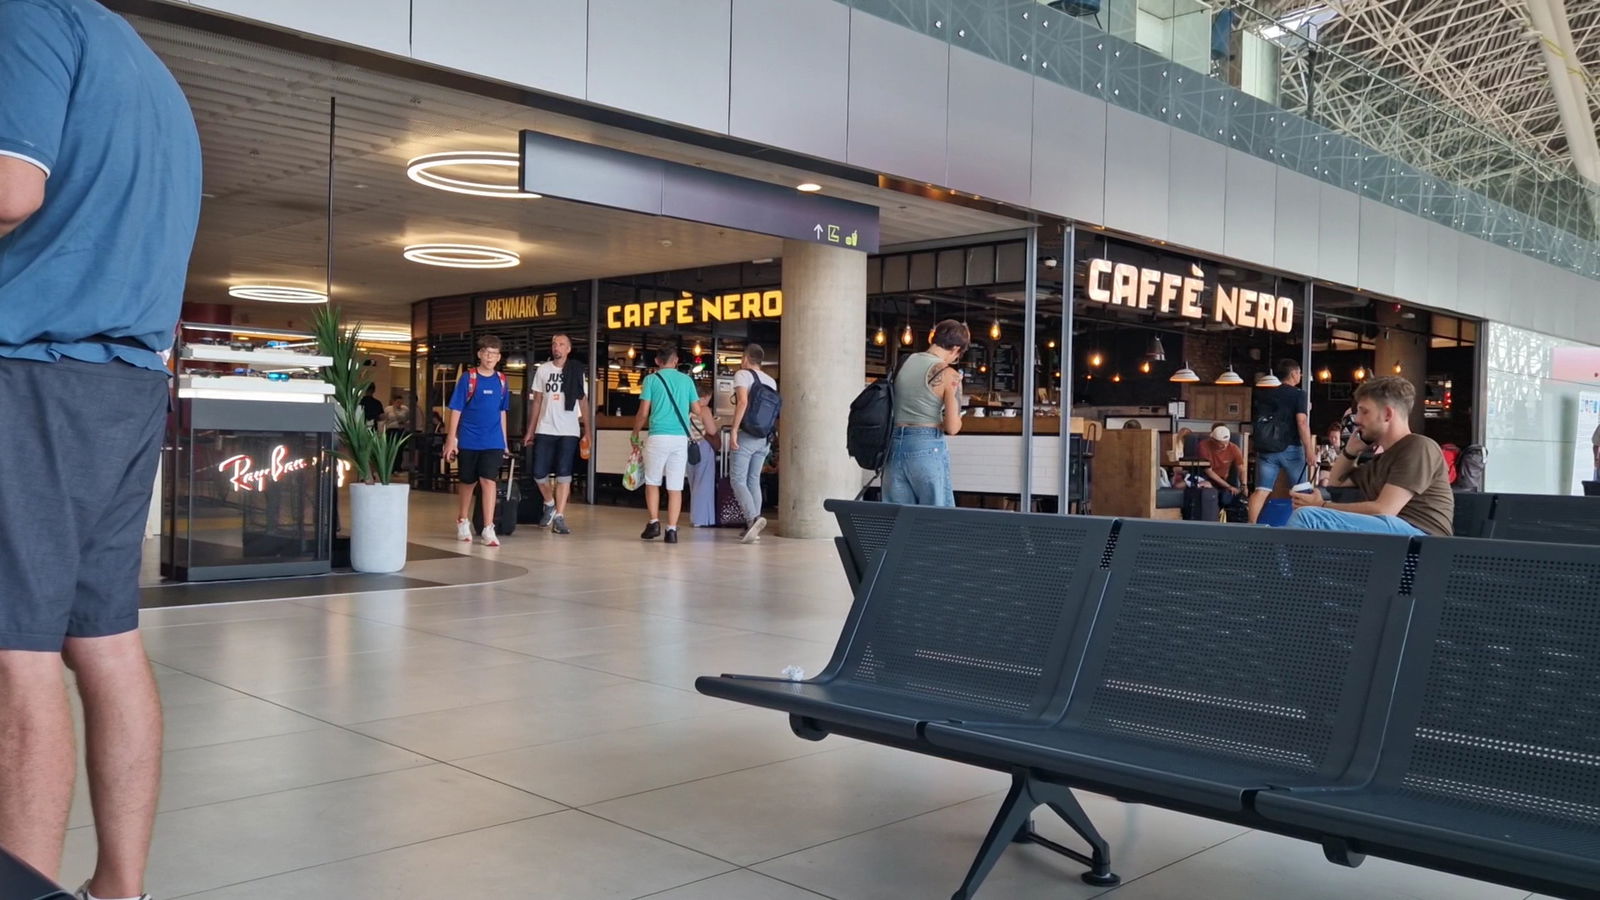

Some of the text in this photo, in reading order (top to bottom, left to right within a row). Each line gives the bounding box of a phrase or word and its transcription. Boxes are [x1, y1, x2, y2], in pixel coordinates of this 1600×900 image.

[485, 294, 557, 320] BREWMARK PUB
[607, 290, 783, 329] CAFFÈ NERO
[1087, 258, 1294, 333] CAFFÈ NERO
[547, 373, 564, 383] JUS
